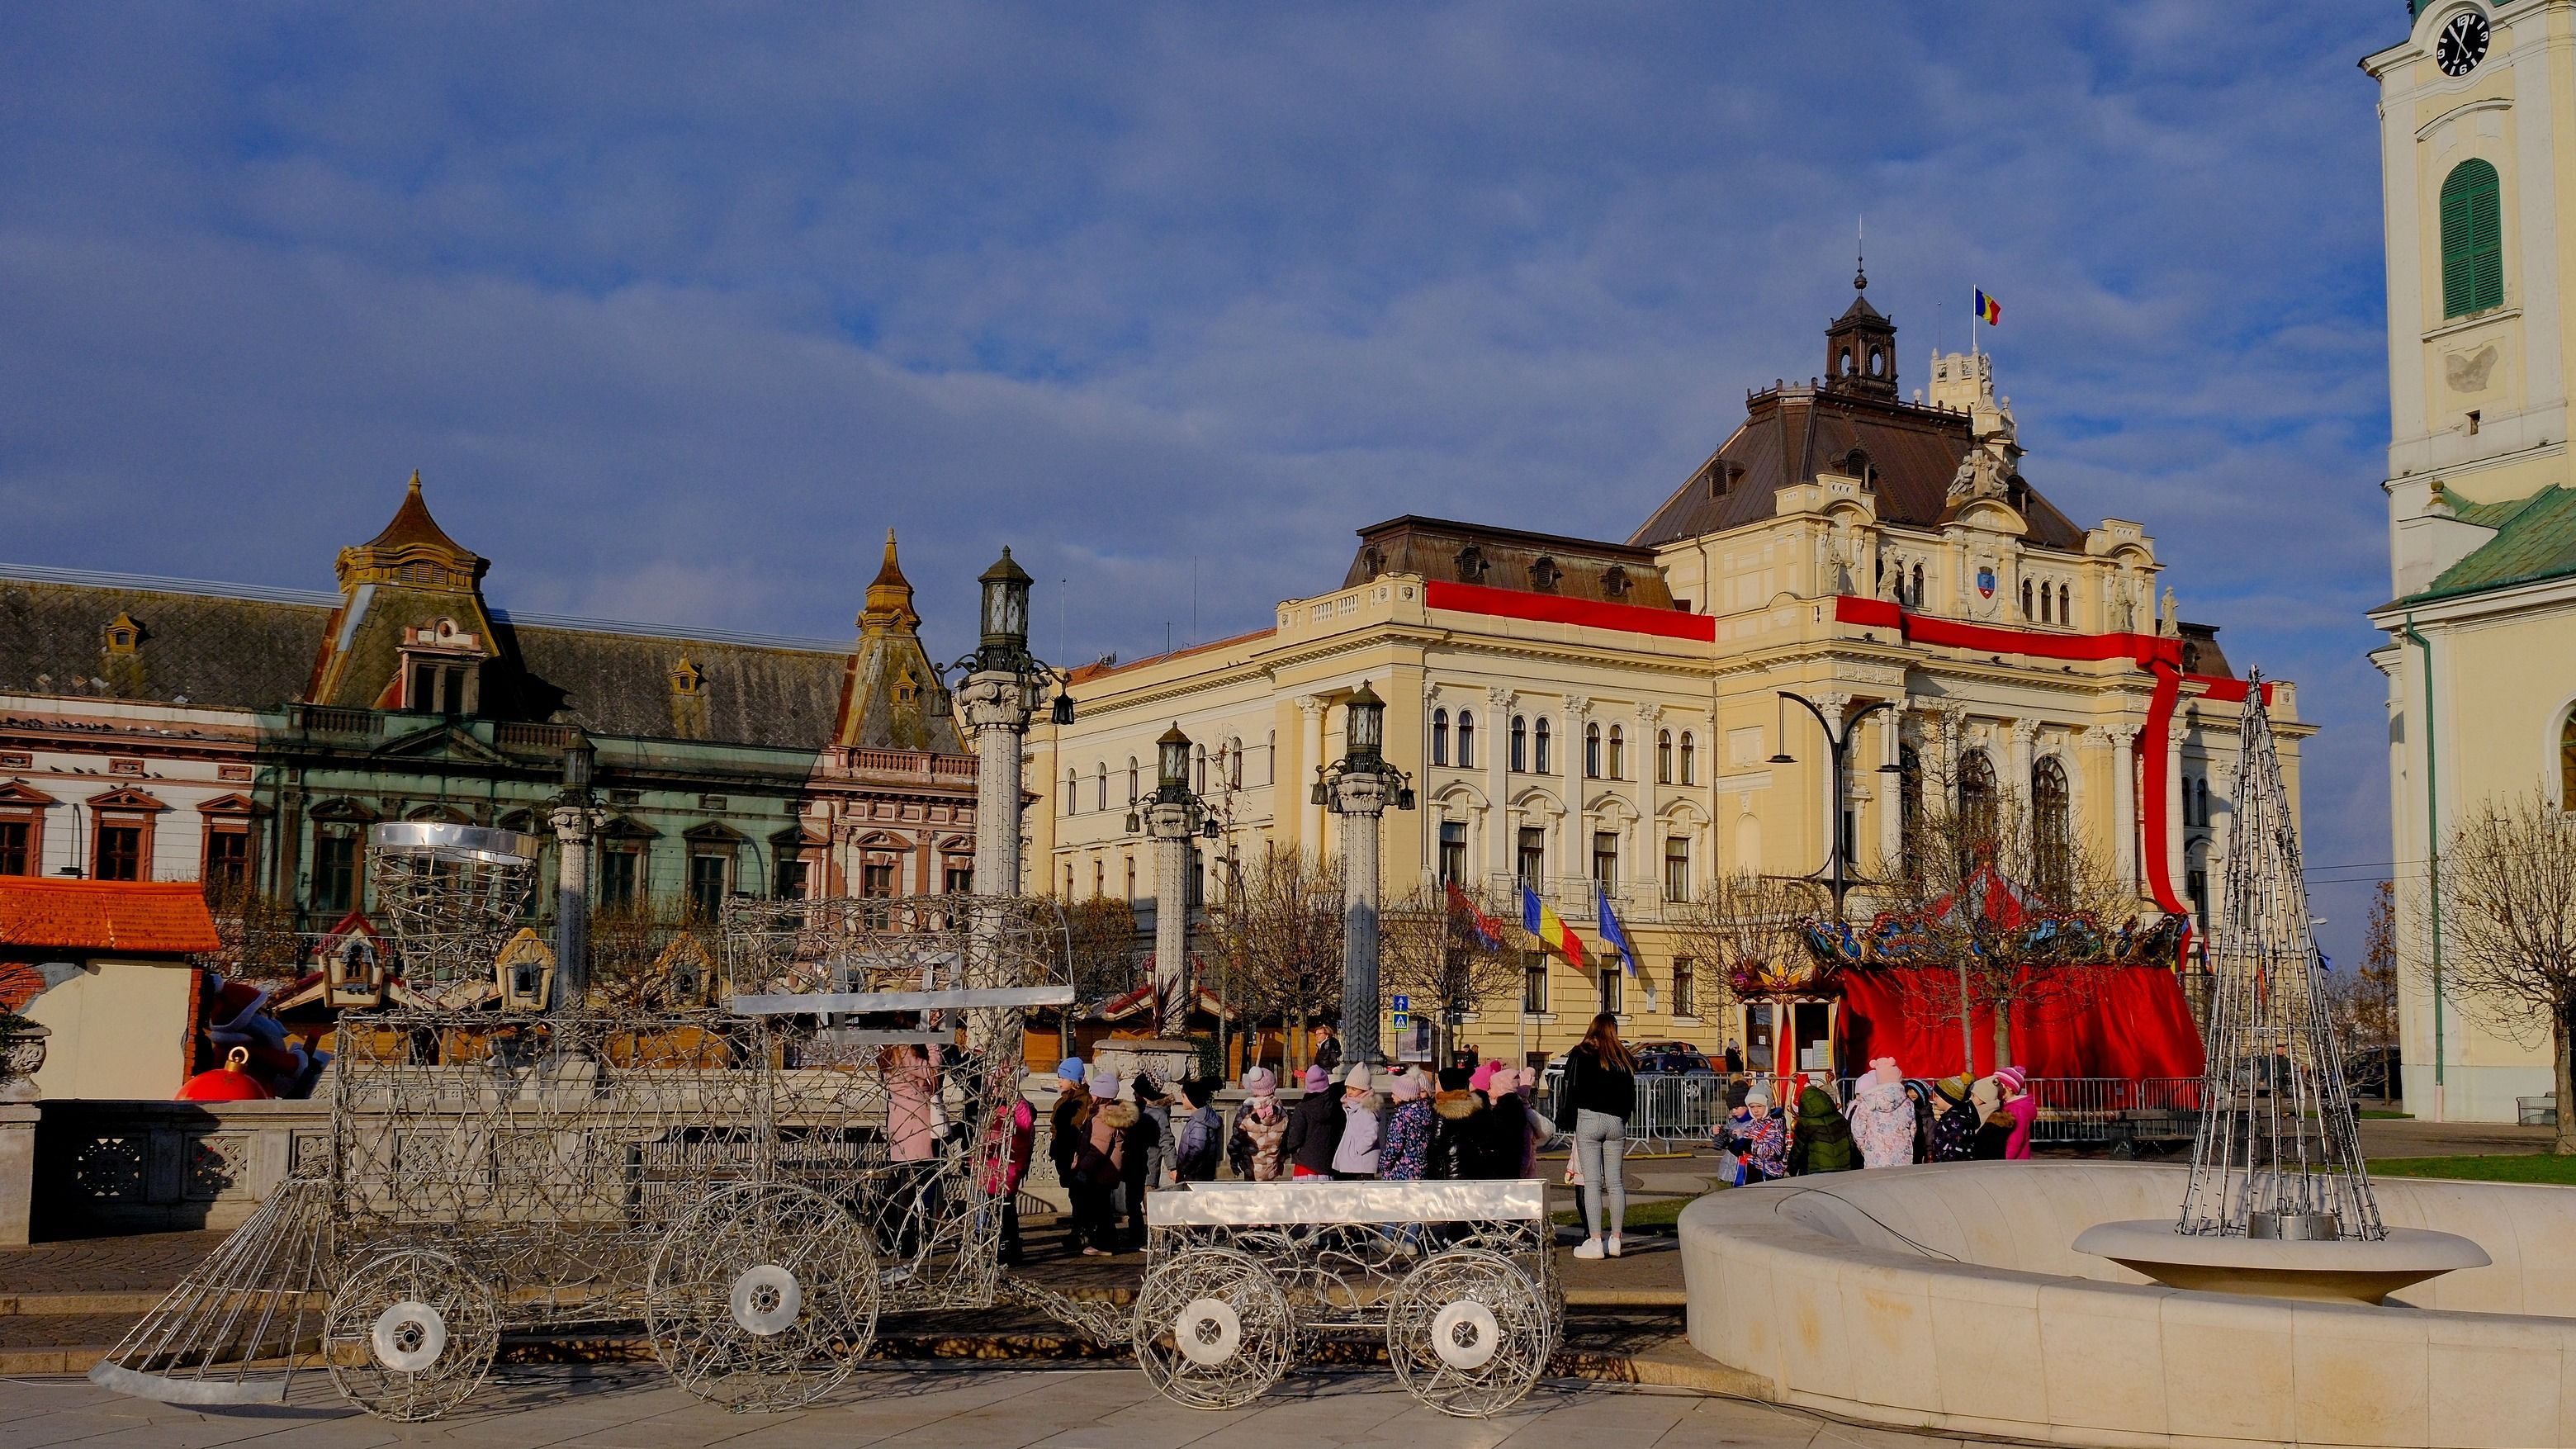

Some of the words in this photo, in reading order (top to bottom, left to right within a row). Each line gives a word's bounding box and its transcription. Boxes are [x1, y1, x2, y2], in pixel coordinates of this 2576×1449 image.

[2457, 15, 2467, 27] 12
[2480, 31, 2488, 41] 3
[2437, 49, 2445, 59] 9
[2460, 64, 2467, 74] 6
